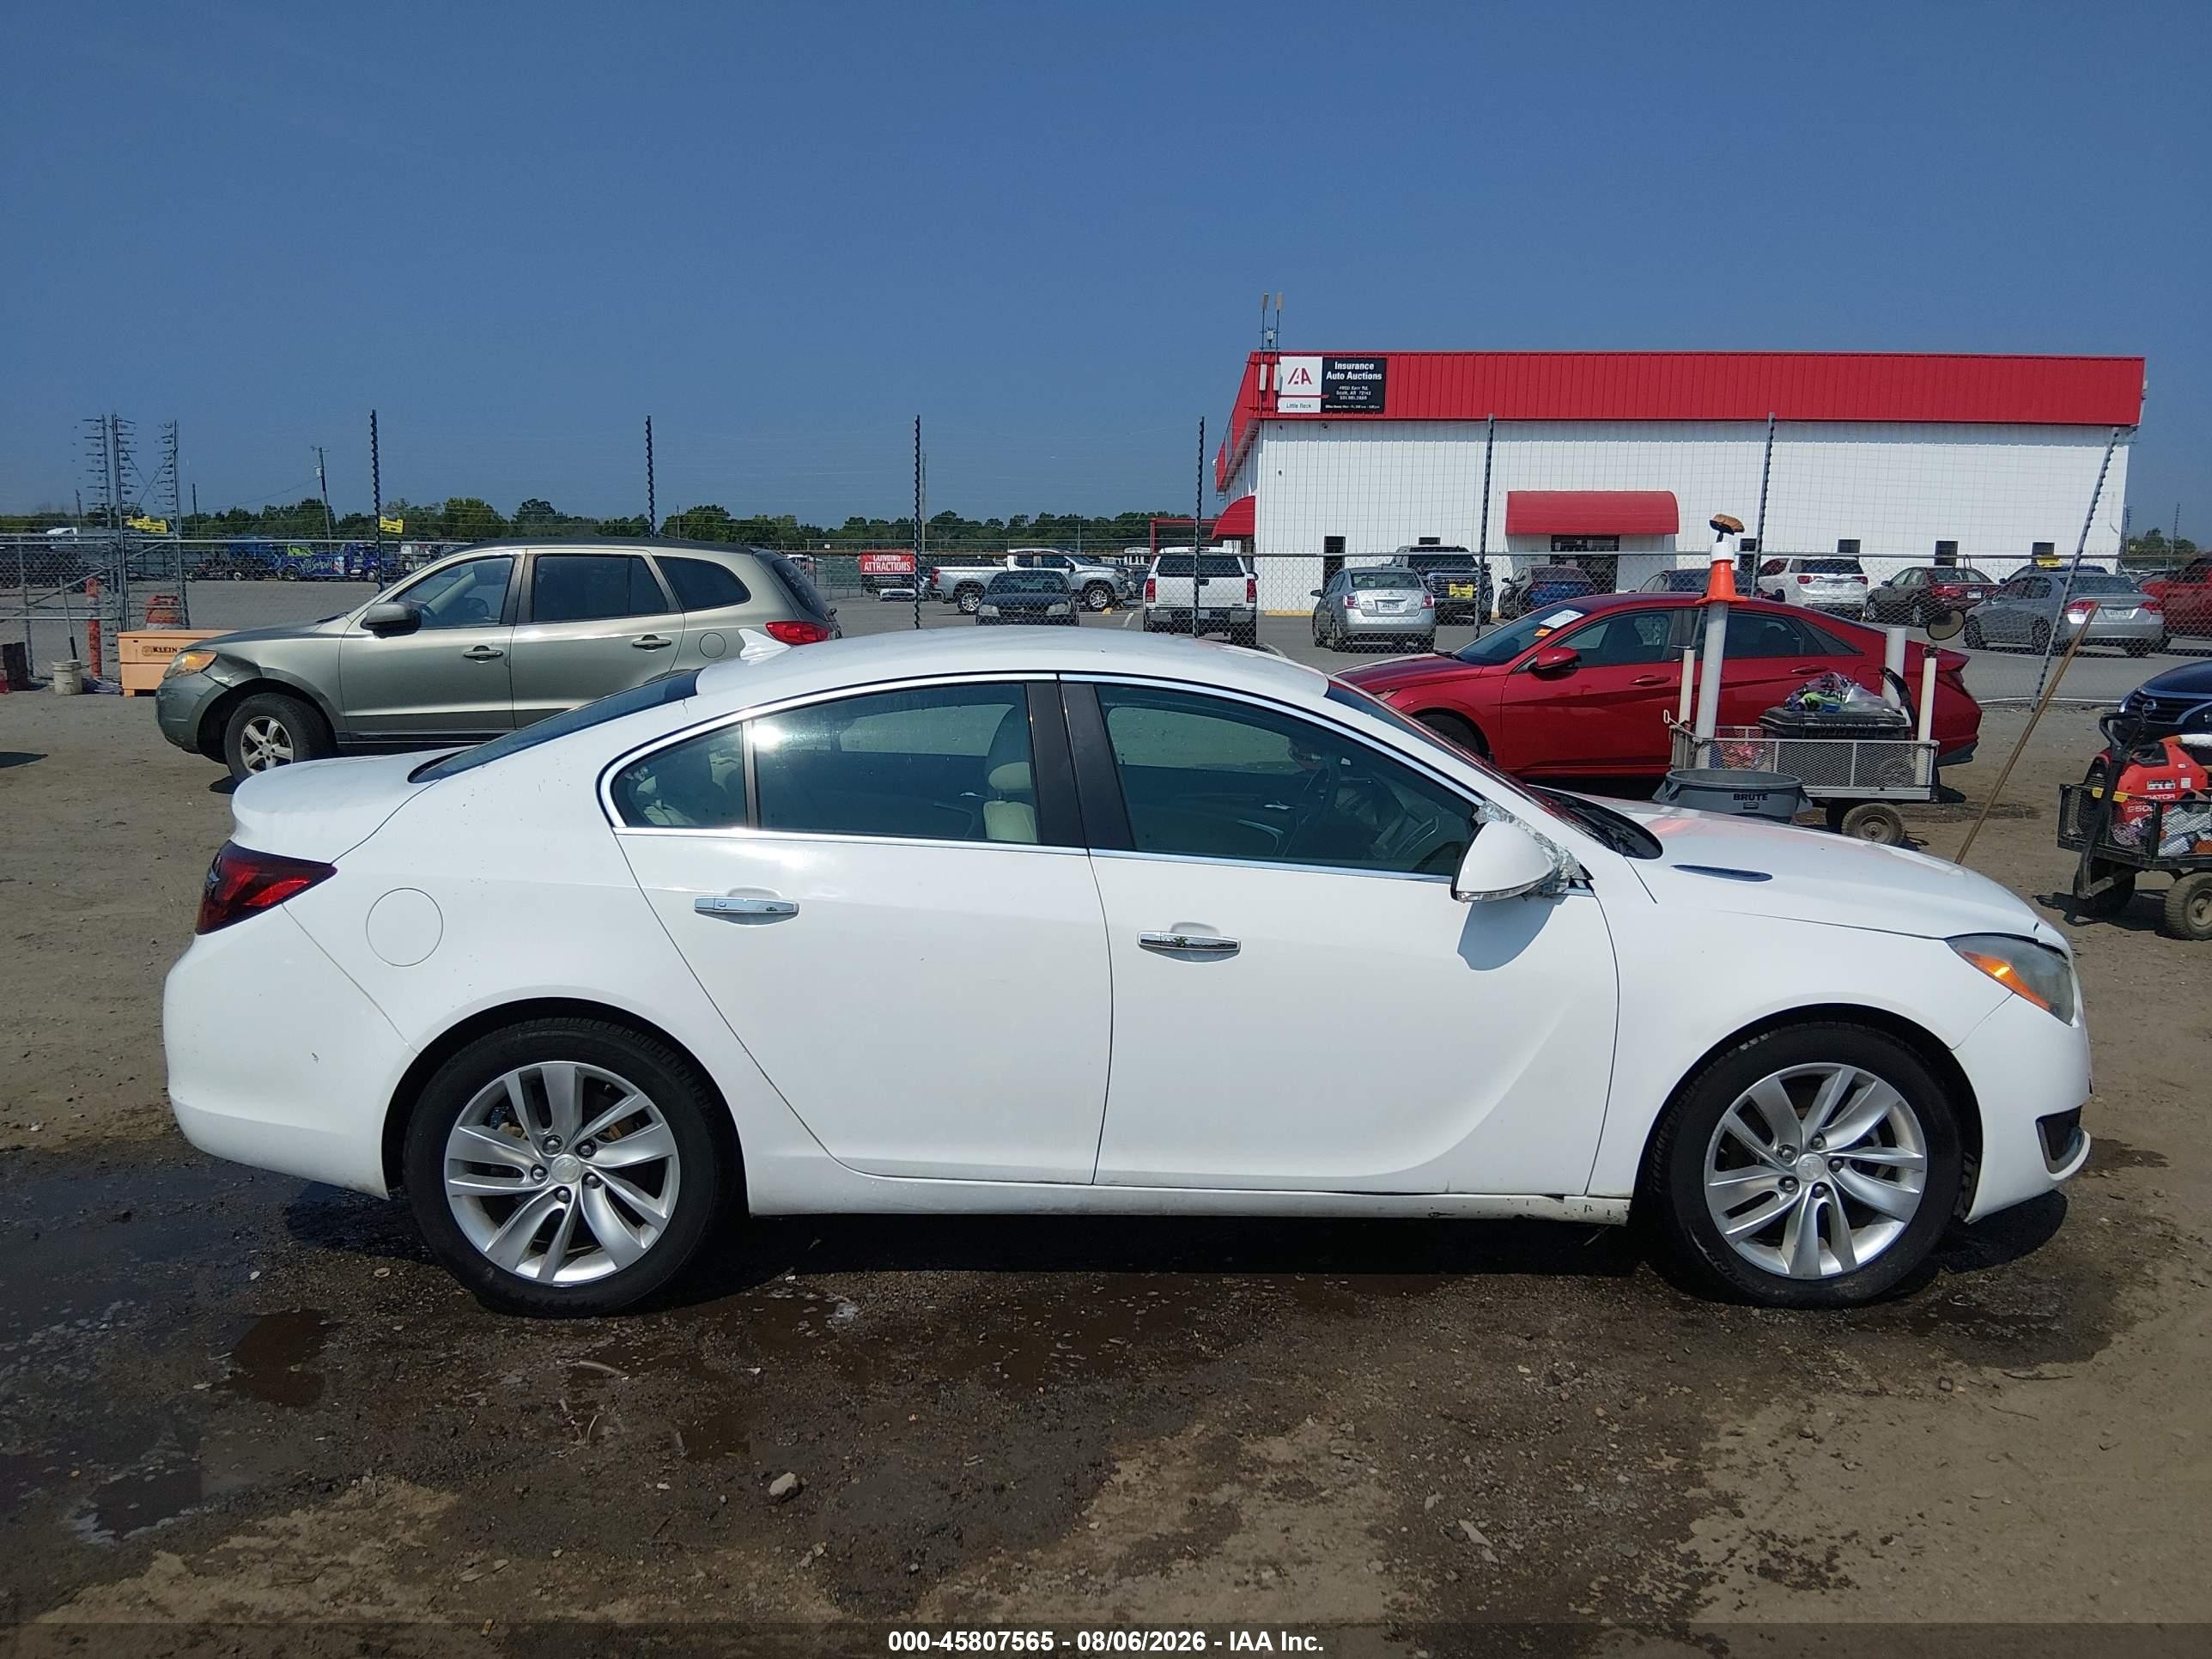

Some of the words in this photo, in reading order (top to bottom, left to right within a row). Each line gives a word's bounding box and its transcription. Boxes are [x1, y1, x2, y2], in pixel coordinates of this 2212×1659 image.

[1334, 362, 1374, 370] Insurance
[1326, 371, 1346, 380] Auto
[1346, 371, 1382, 380] Auctions
[864, 562, 911, 572] ATTRACTIONS
